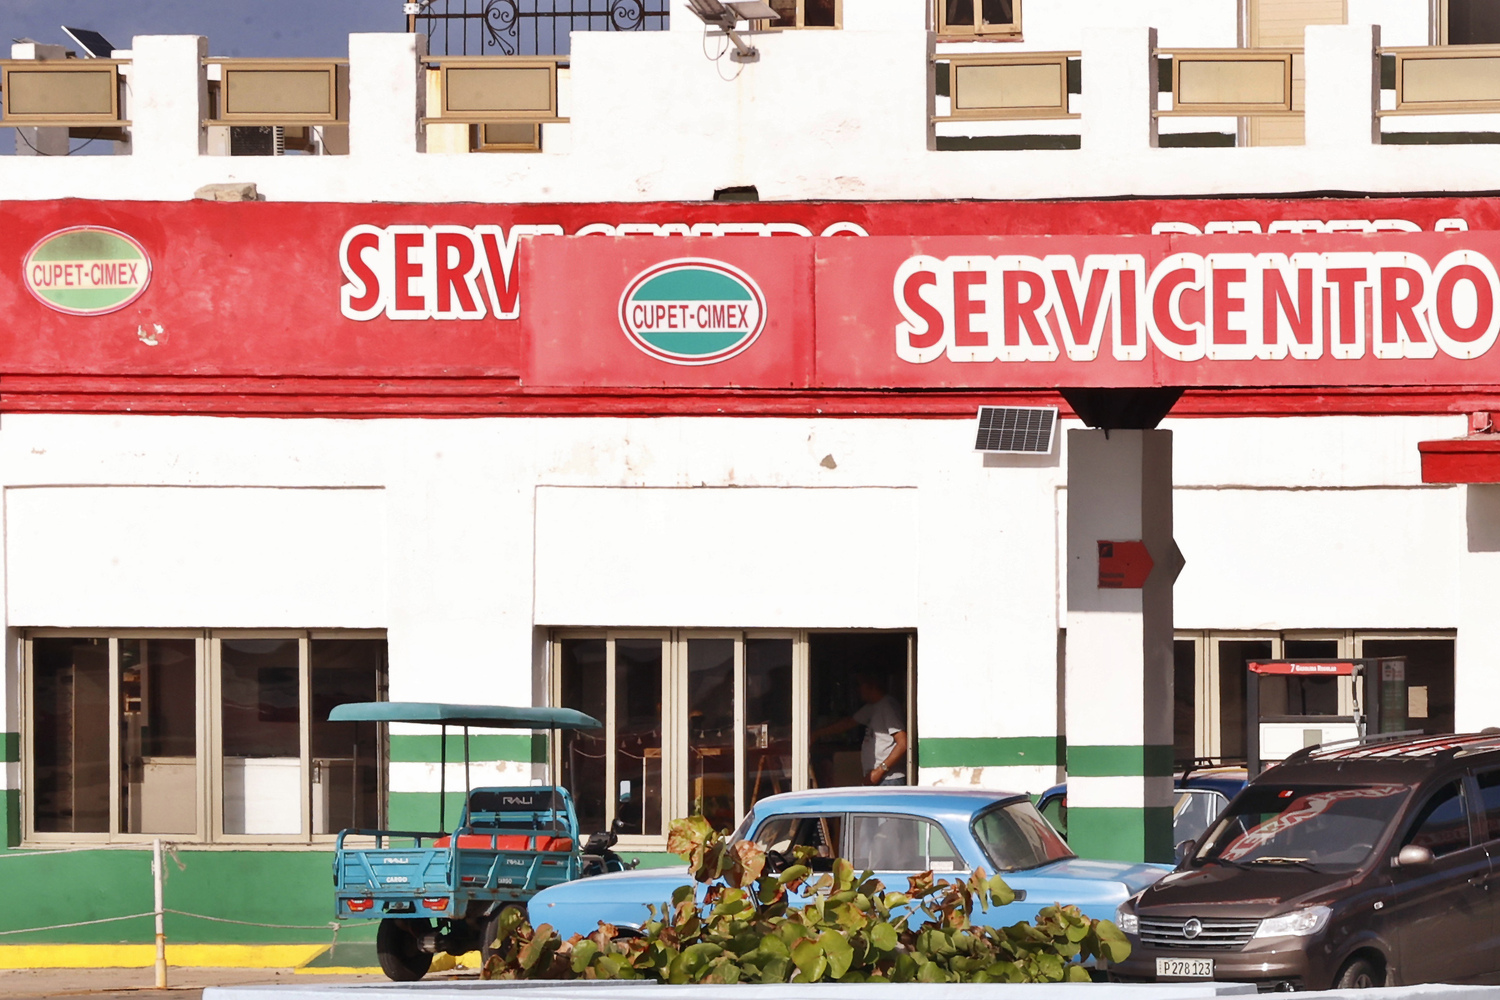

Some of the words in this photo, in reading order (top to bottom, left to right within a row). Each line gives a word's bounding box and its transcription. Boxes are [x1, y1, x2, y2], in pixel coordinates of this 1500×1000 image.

[32, 262, 139, 287] CUPET-CIMEX
[632, 303, 749, 329] CUPET-CIMEX
[898, 257, 1498, 355] SERVICENTRO
